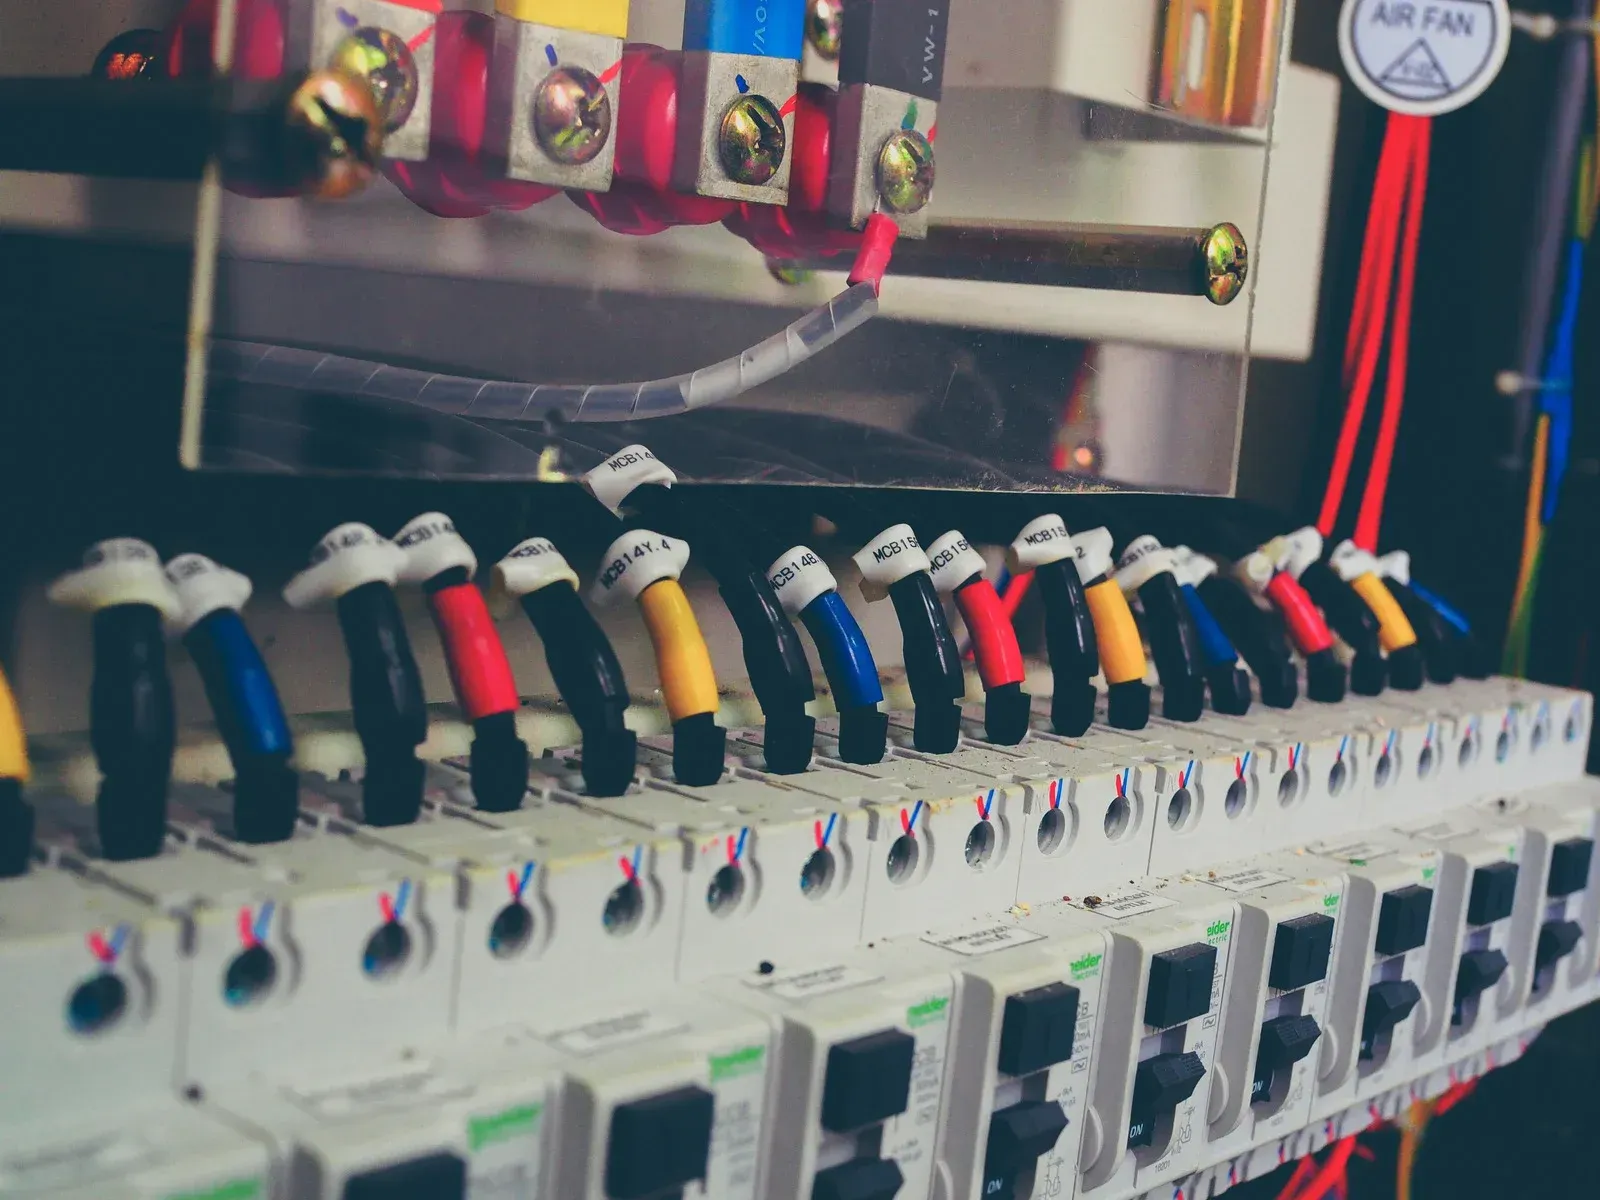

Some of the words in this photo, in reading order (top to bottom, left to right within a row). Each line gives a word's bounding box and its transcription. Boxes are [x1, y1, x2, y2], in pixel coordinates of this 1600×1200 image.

[1370, 2, 1416, 29] AIR
[1421, 6, 1475, 37] FAN
[922, 8, 939, 84] VW-1
[1130, 1123, 1144, 1139] ON
[987, 1178, 1003, 1195] ON
